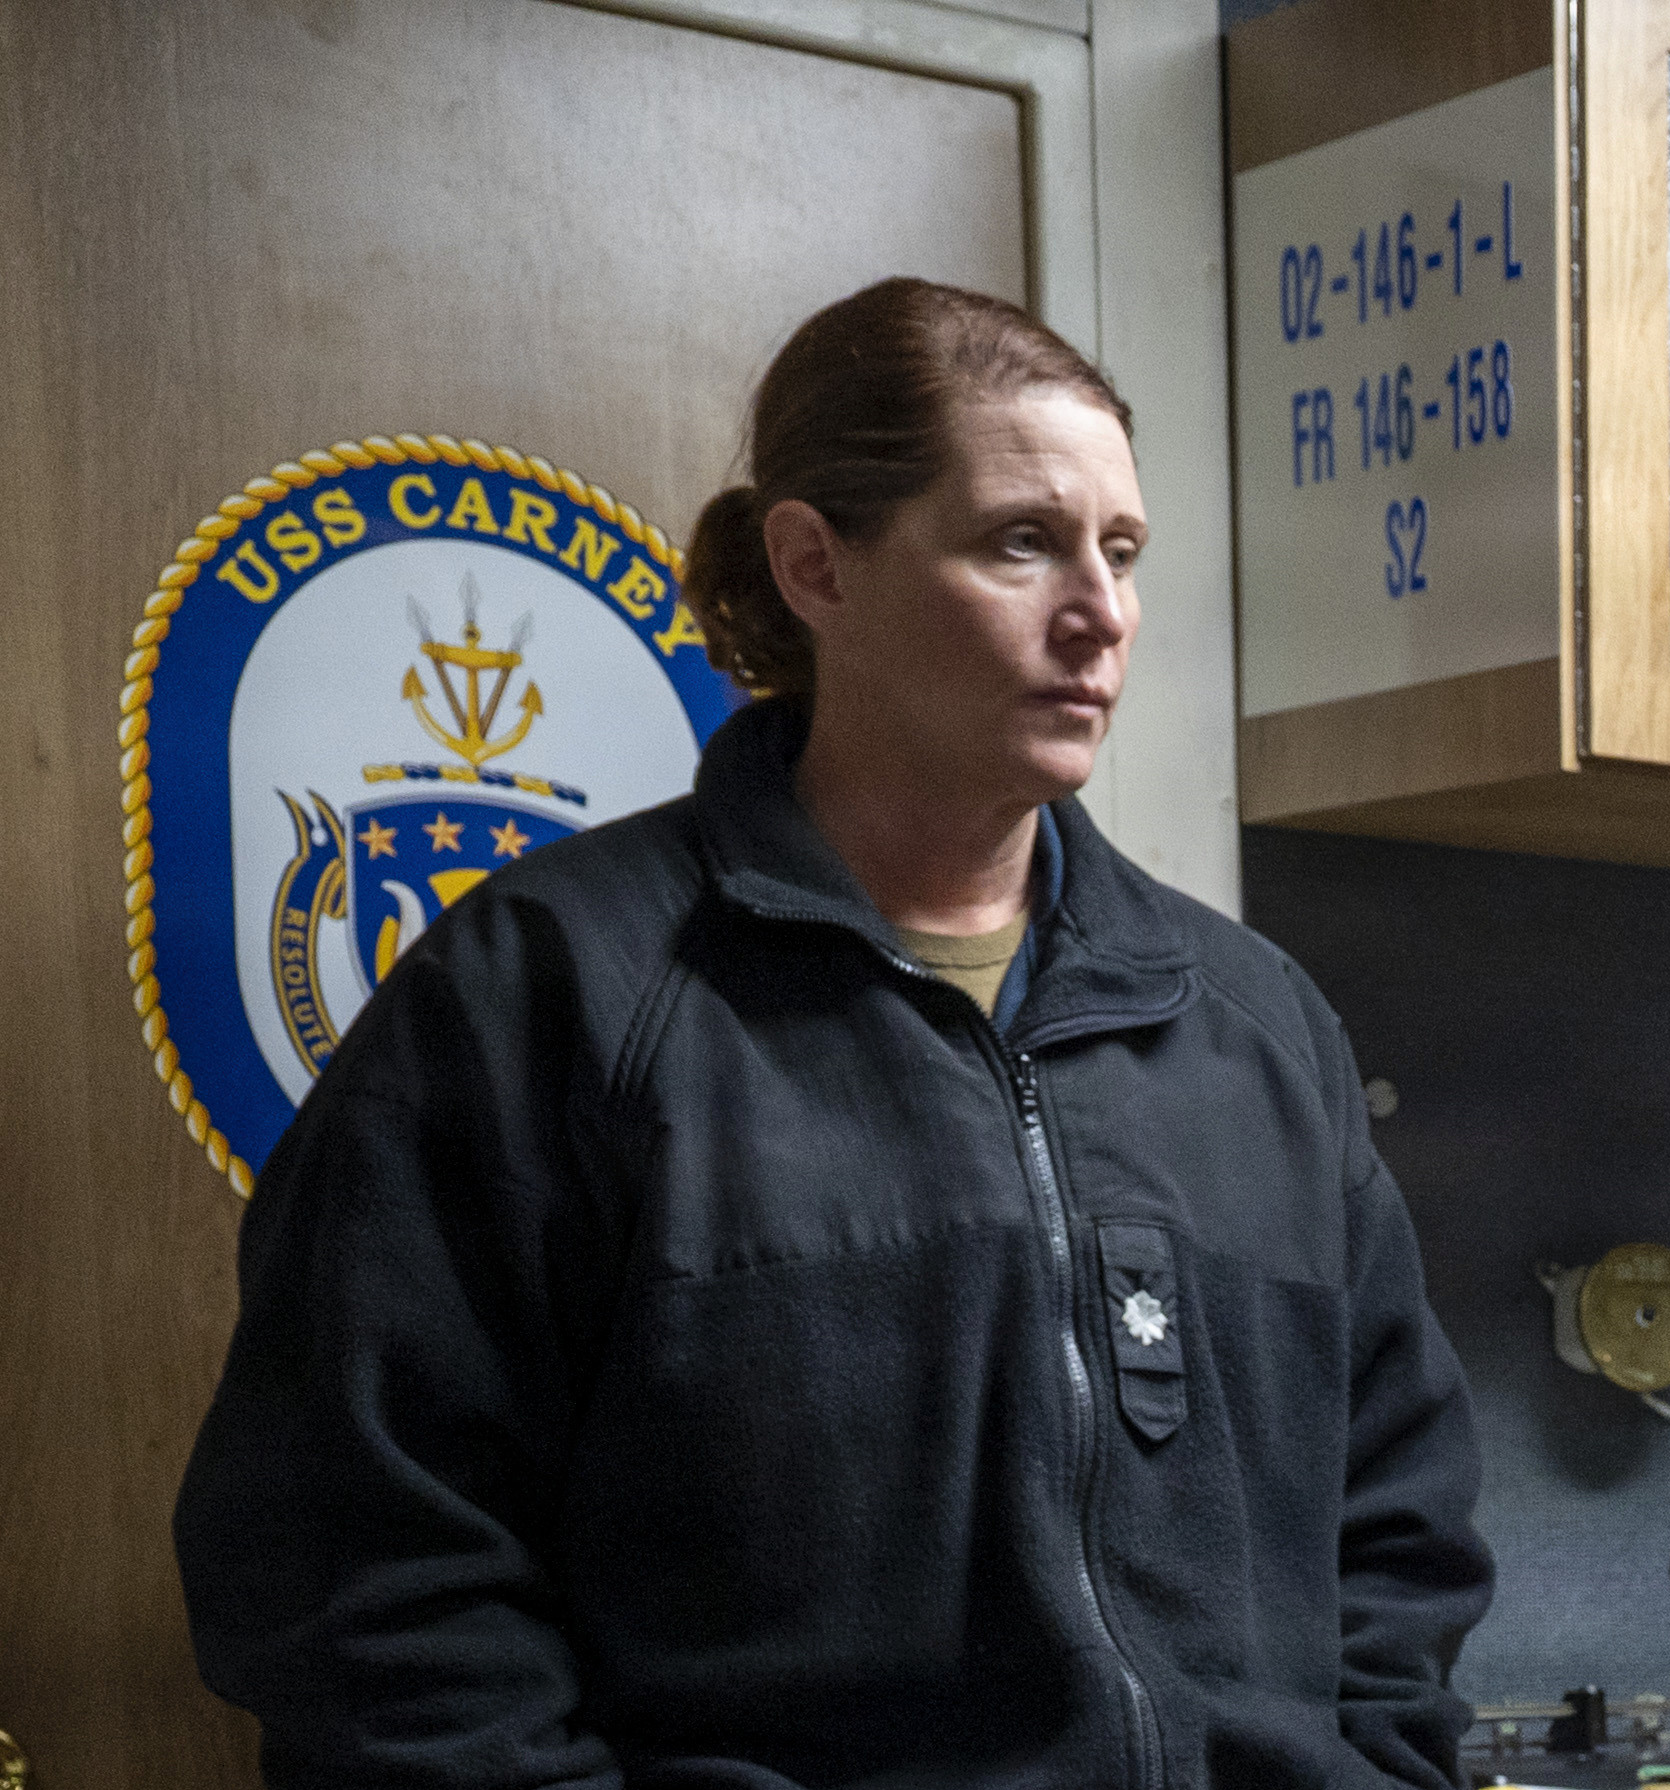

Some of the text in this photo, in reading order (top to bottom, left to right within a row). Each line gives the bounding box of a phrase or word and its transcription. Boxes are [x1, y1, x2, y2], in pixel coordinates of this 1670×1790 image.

[1280, 180, 1523, 344] 02-146-1-L
[1292, 339, 1513, 488] FR 146-158
[216, 474, 706, 657] USS CARNEY
[1384, 496, 1429, 600] S2
[281, 907, 335, 1060] RESOLUTE
